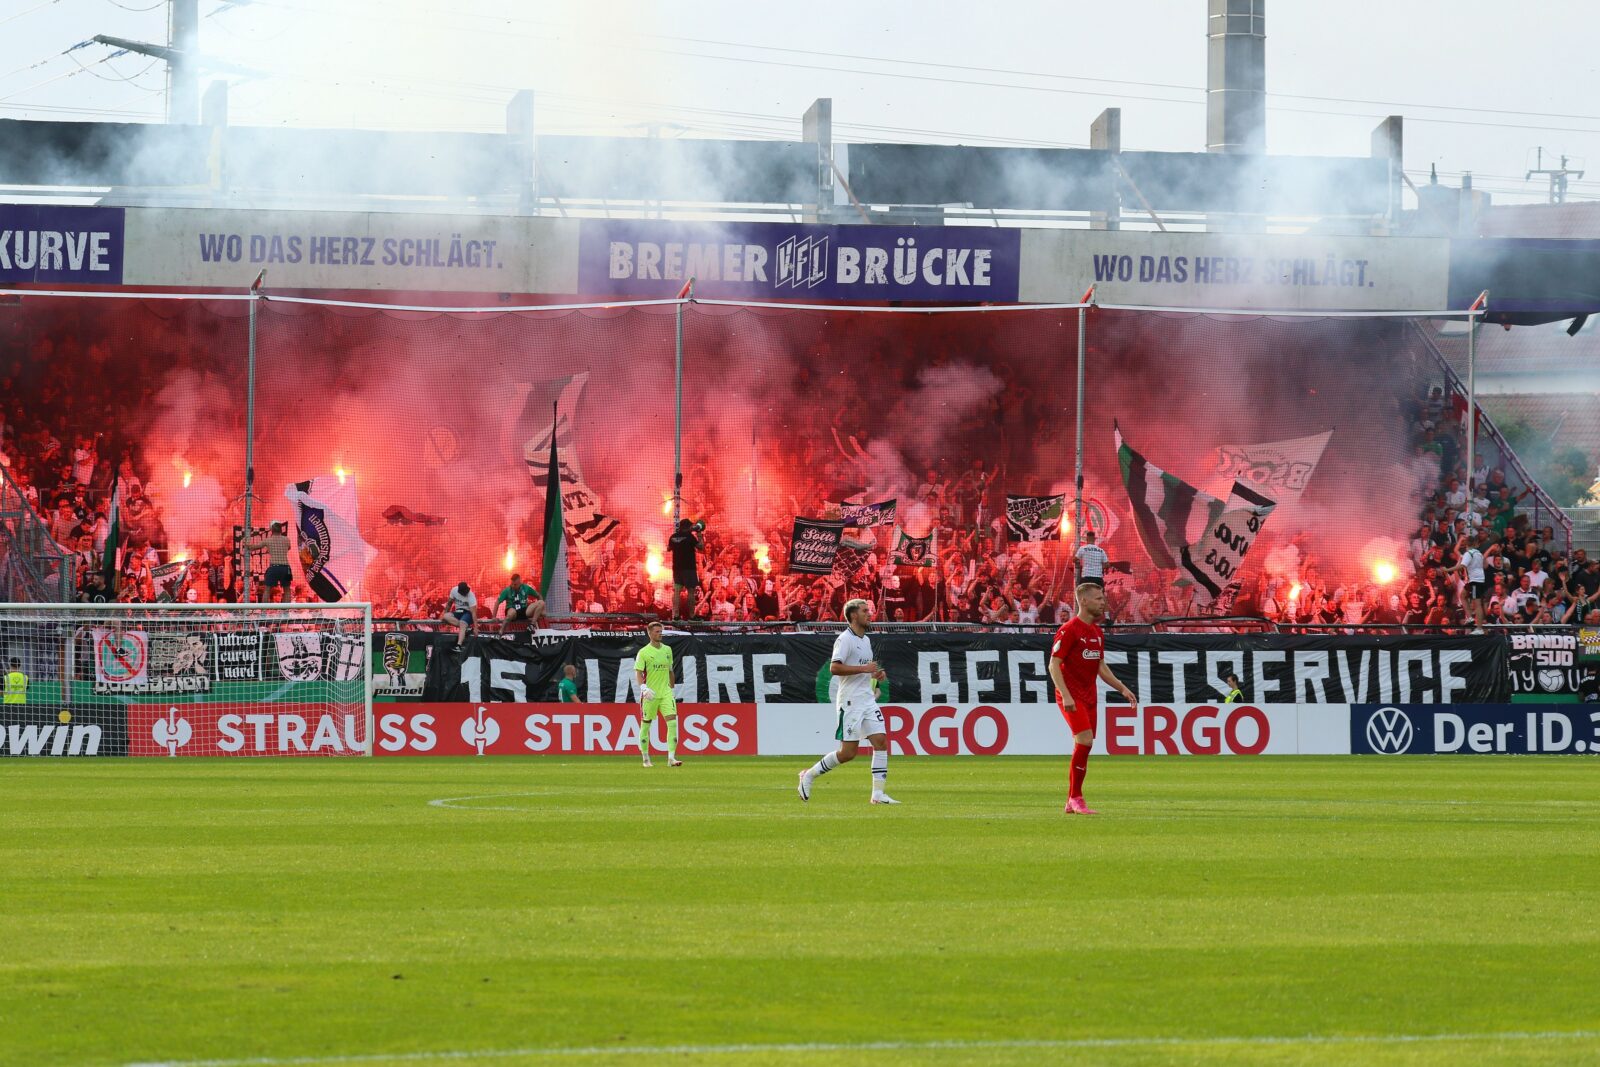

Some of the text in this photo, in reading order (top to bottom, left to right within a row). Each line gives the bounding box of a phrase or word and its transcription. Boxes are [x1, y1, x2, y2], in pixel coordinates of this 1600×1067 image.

[200, 233, 503, 268] WO DAS HERZ SCHLÄGT.
[609, 241, 768, 282] BREMER
[836, 237, 992, 286] BRÜCKE
[1093, 253, 1374, 287] WO DAS HERZ SCHLÄGT.
[1510, 634, 1577, 650] BANDA
[1536, 650, 1574, 667] SUD
[373, 686, 423, 698] poebel
[460, 655, 527, 703] 15
[0, 711, 102, 755] win
[216, 713, 437, 752] STRAUSS
[523, 713, 740, 752] STRAUSS
[858, 705, 1009, 755] RGO
[1105, 705, 1271, 755] ERGO
[1433, 712, 1514, 753] Der
